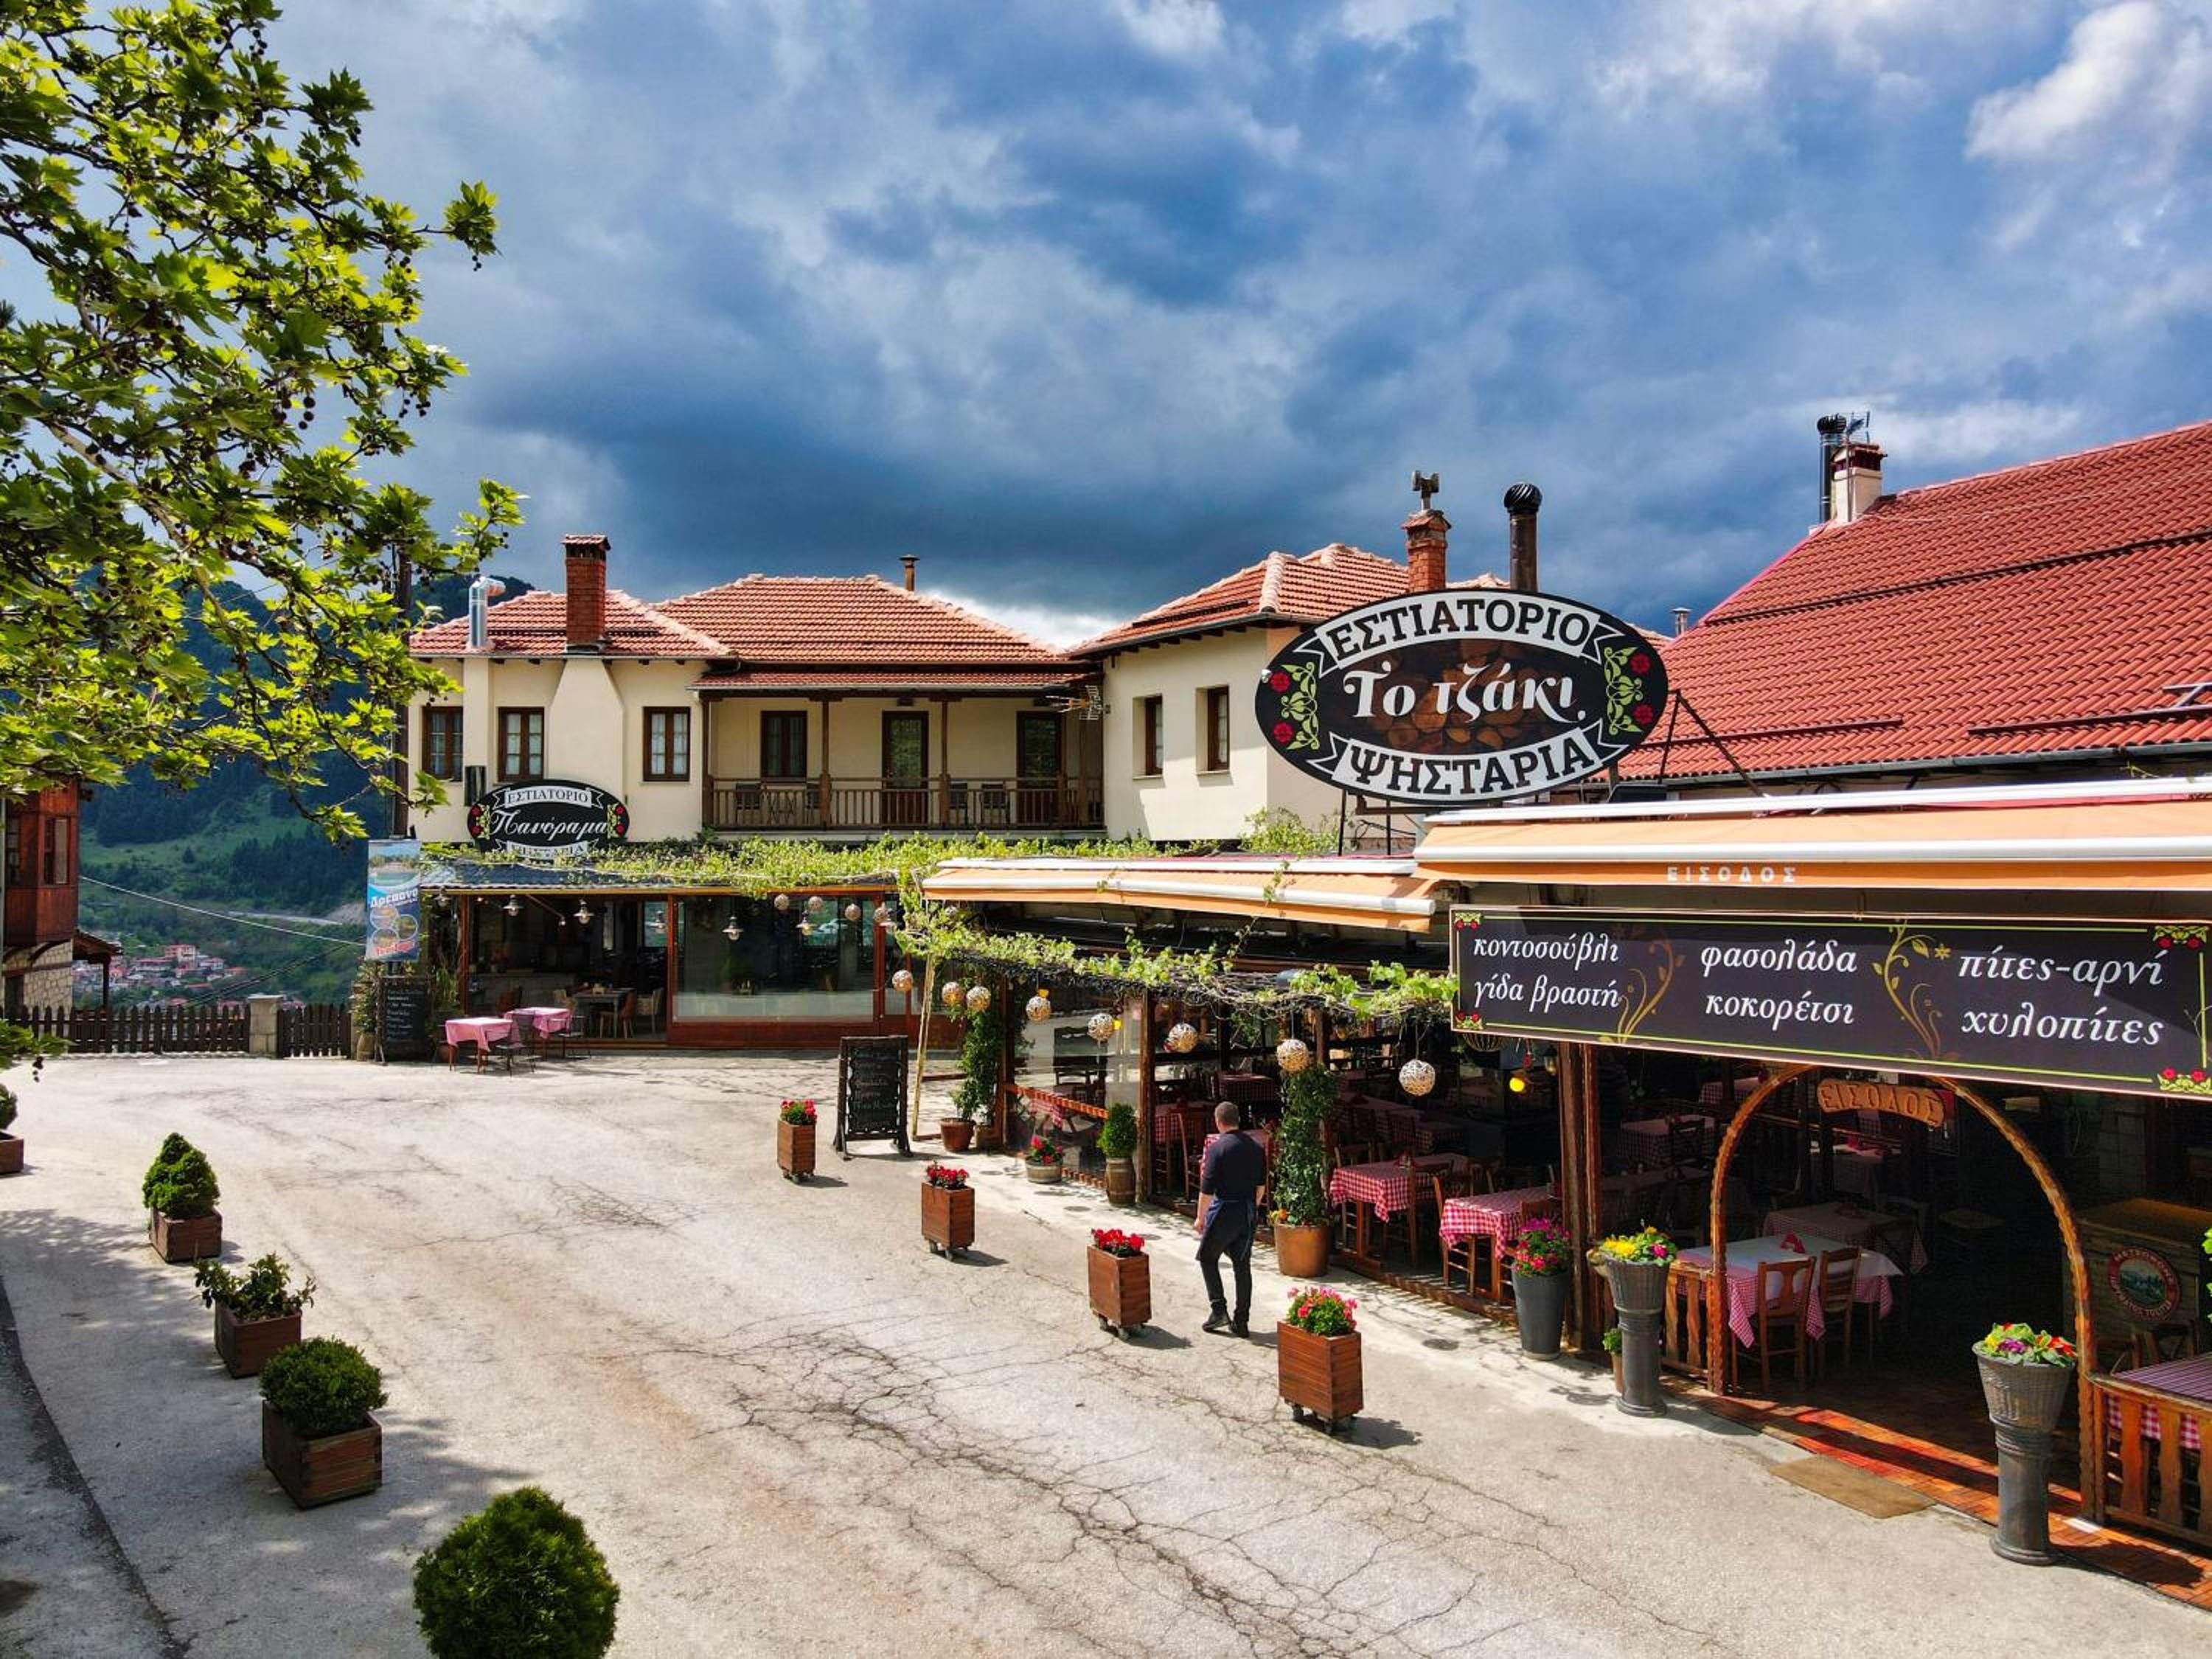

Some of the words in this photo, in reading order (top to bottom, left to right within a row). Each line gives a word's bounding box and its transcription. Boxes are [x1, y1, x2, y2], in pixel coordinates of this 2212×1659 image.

[1327, 599, 1591, 661] ΕΣΤΙΑΤΟΡΙΟ
[1343, 661, 1416, 718] Το
[1433, 662, 1586, 723] τζάκι
[1349, 738, 1595, 796] ΨΗΣΤΑΡΙΑ
[508, 789, 588, 804] ΕΣΤΙΑΤΟΡΙΟ
[490, 810, 608, 841] Πανόραμα
[1666, 866, 1796, 883] ΕΙΣΟΔΟΣ
[1473, 932, 1619, 970] κοντοσούβλι
[1700, 939, 1857, 977] φασολάδα
[1958, 945, 2168, 996] πίτες-αρνί
[1474, 973, 1524, 1008] γίδα
[1528, 974, 1621, 1013] βραστή
[1705, 990, 1854, 1032] κοκορέτσι
[1961, 1001, 2165, 1046] χυλοπίτες
[1820, 1085, 1941, 1124] ΕΙΣΟΔΟΣ
